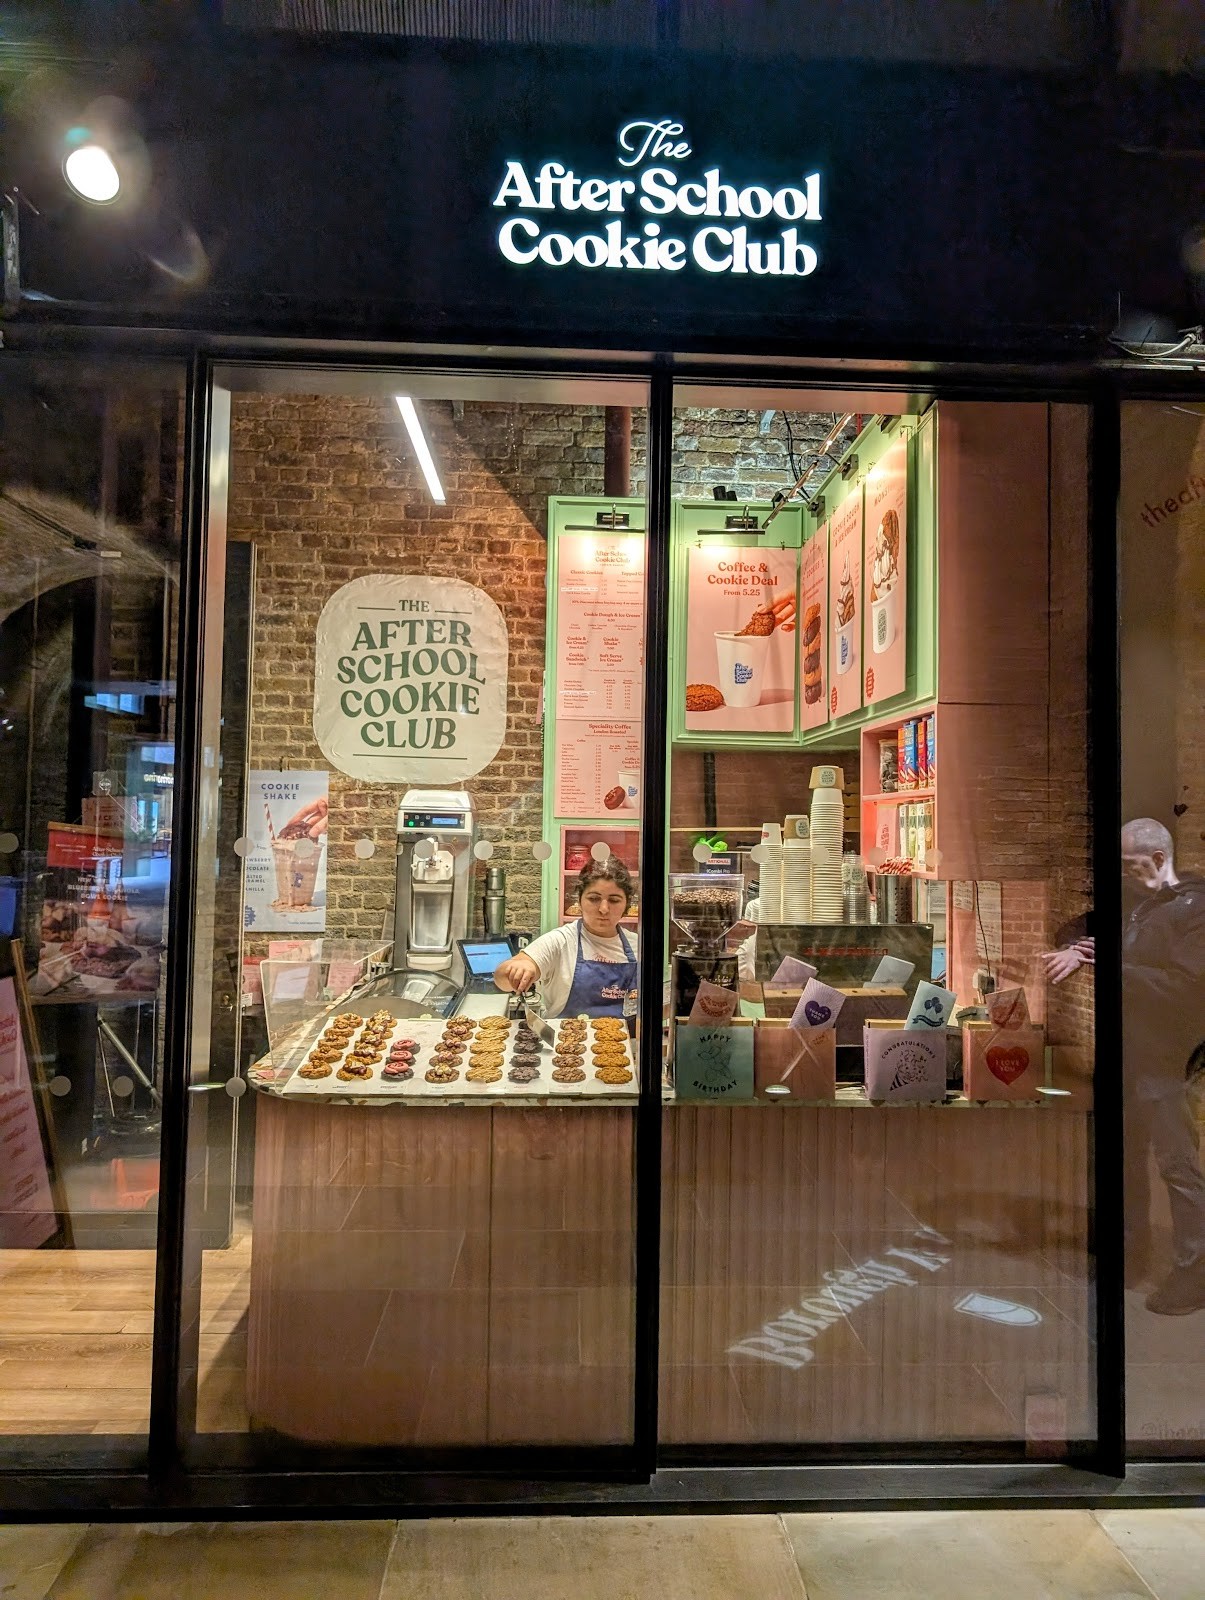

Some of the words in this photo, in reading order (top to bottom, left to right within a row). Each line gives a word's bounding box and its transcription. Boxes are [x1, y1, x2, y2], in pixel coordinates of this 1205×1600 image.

[618, 119, 692, 167] The
[493, 161, 636, 212] After
[639, 167, 823, 221] School
[498, 217, 687, 271] Cookie
[692, 225, 818, 276] Club
[718, 562, 755, 572] Coffee
[758, 562, 768, 573] &
[707, 575, 749, 586] Cookie
[752, 575, 778, 586] Deal
[399, 600, 430, 613] THE
[351, 619, 473, 651] AFTER
[337, 648, 486, 685] SCHOOL
[340, 681, 480, 718] COOKIE
[360, 717, 456, 750] CLUB
[261, 783, 300, 791] COOKIE
[700, 1033, 732, 1043] HAPPY
[881, 1041, 937, 1060] CONGRATULATIONS
[1001, 1059, 1020, 1067] LOVE
[693, 1079, 738, 1093] BIRTHDAY
